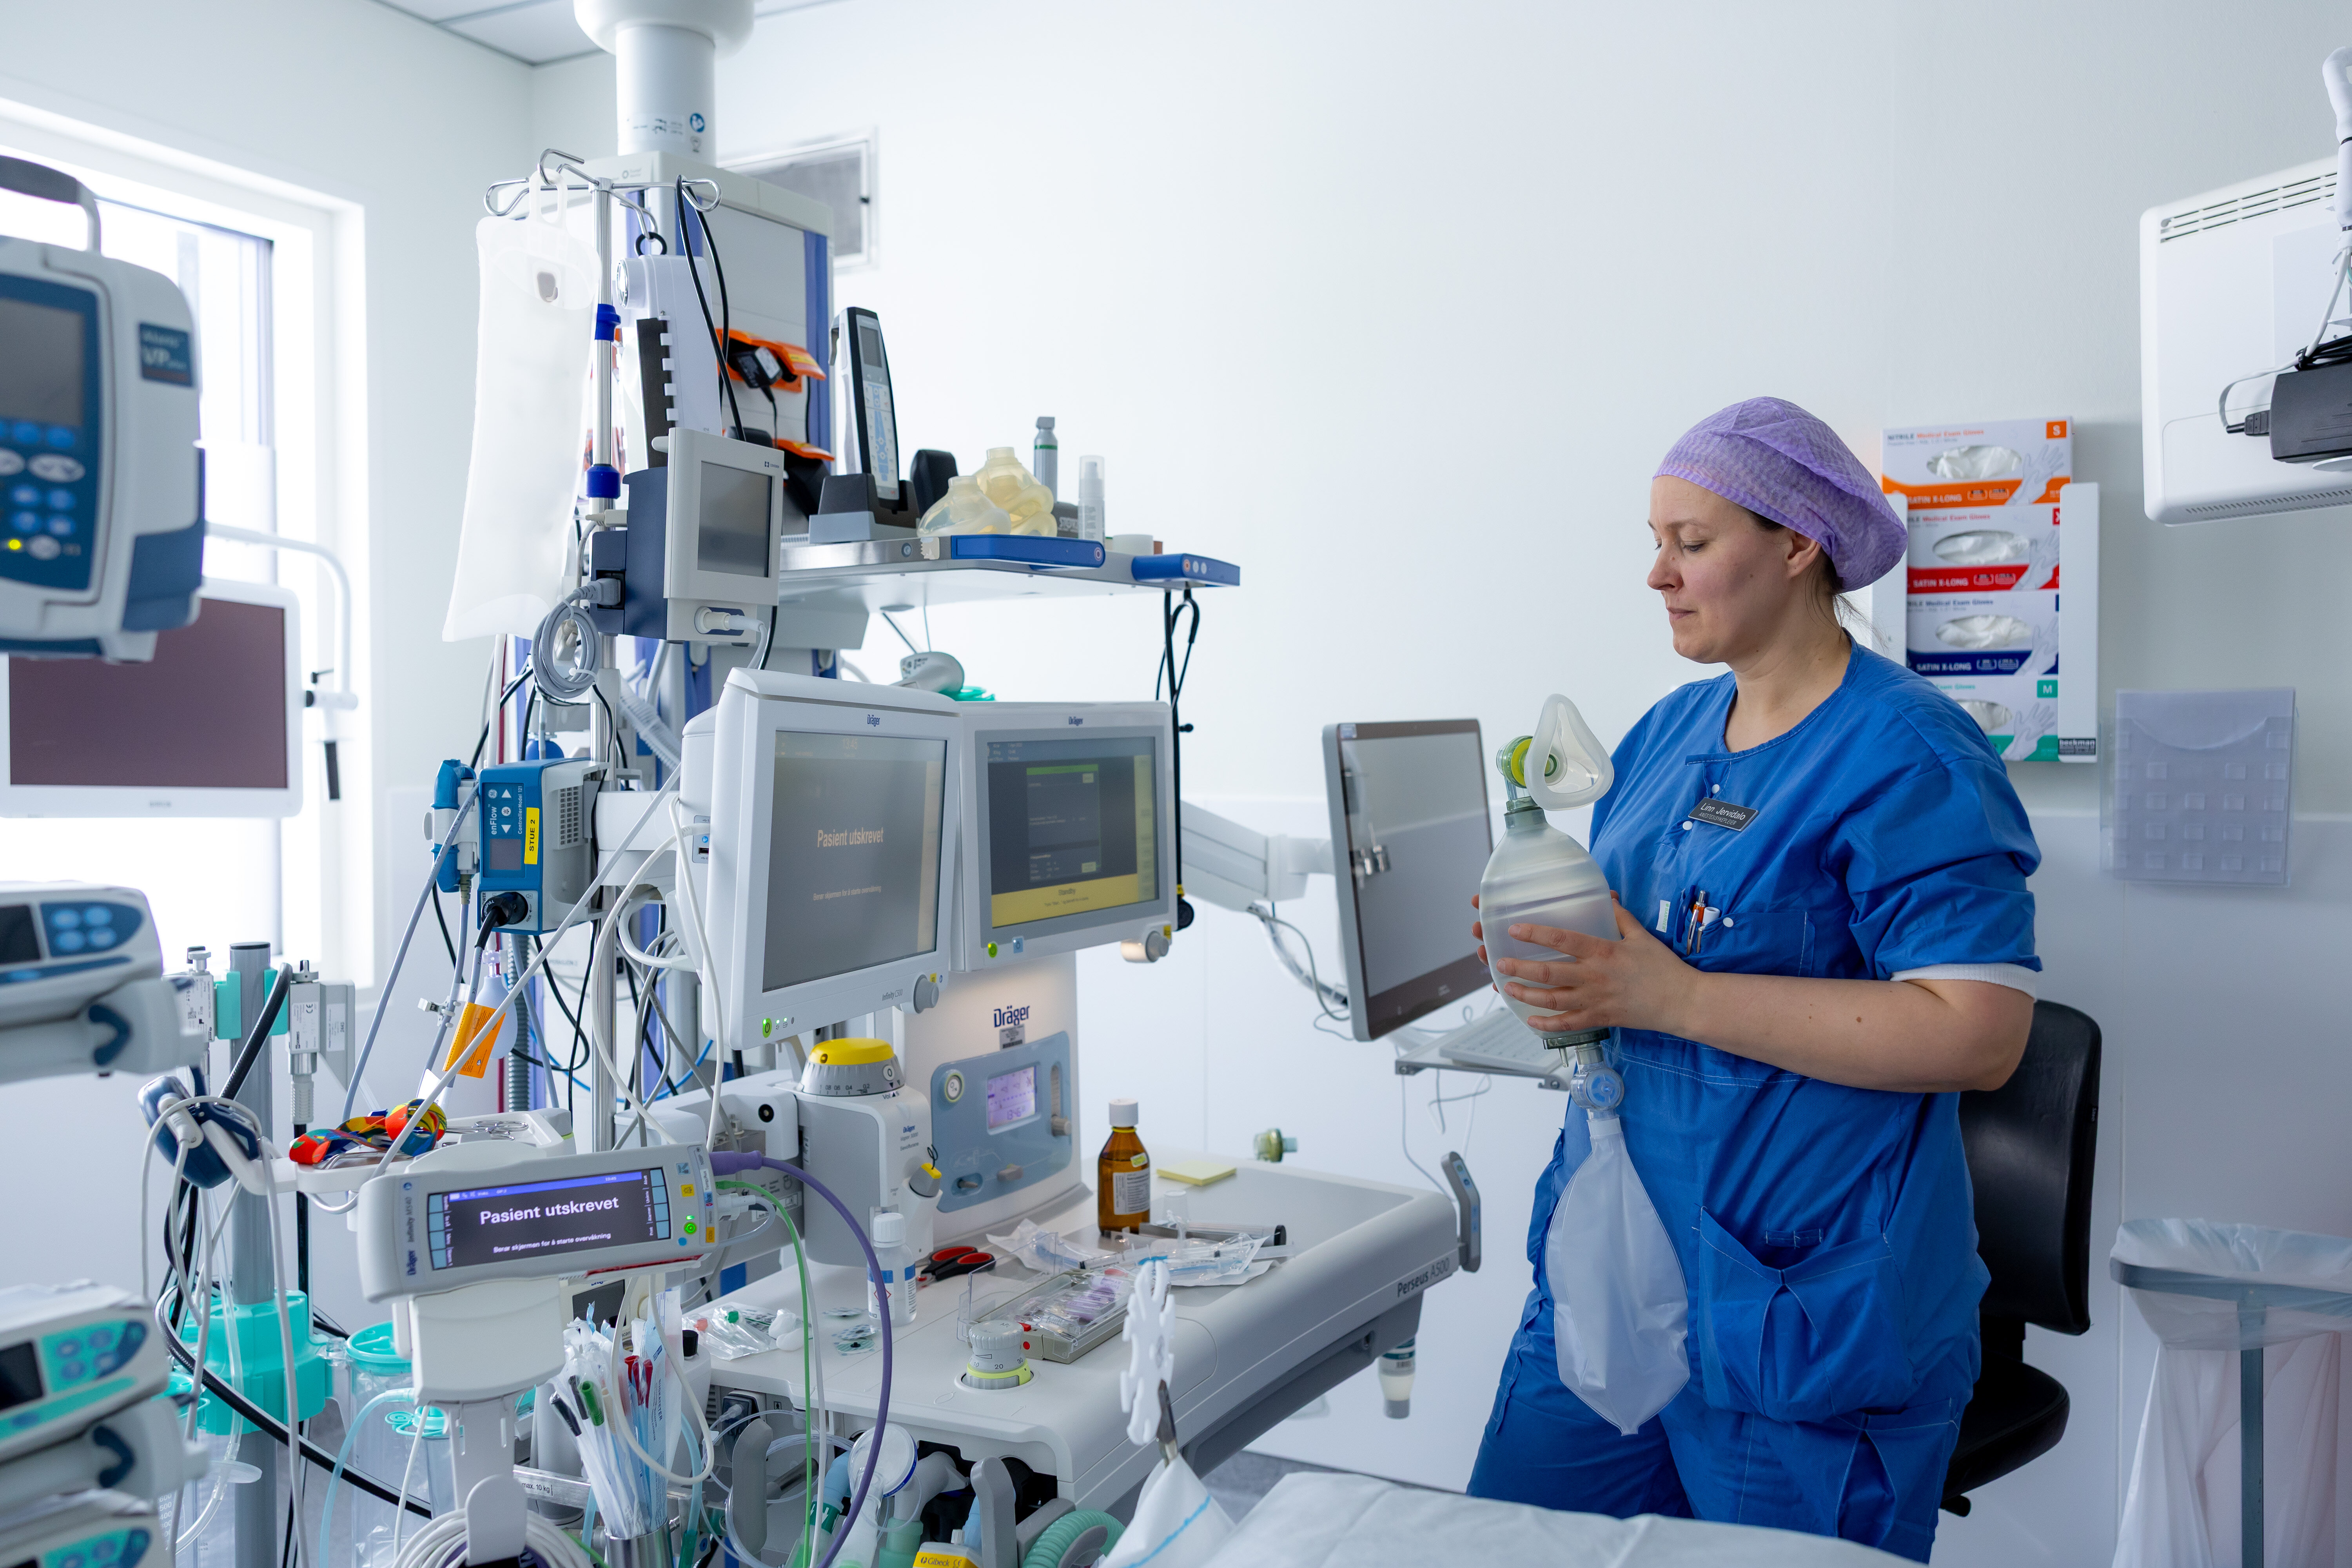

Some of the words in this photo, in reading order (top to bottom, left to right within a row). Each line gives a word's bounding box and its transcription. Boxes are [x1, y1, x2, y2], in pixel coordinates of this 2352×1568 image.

[2052, 425, 2061, 436] S
[2043, 685, 2052, 693] M
[867, 714, 880, 727] Dräger
[1700, 803, 1715, 812] Linn
[1716, 807, 1746, 820] Jervidalo
[817, 829, 848, 848] Pasient
[849, 827, 884, 845] utskrevet
[882, 991, 895, 1001] Infinity
[895, 989, 903, 998] C500
[994, 1005, 1030, 1028] Dräger
[480, 1205, 541, 1225] Pasient
[545, 1197, 619, 1217] utskrevet
[541, 1239, 550, 1247] for
[1397, 1271, 1429, 1298] Perseus
[543, 1485, 550, 1494] kg
[159, 1501, 172, 1512] 500
[159, 1511, 172, 1520] 400
